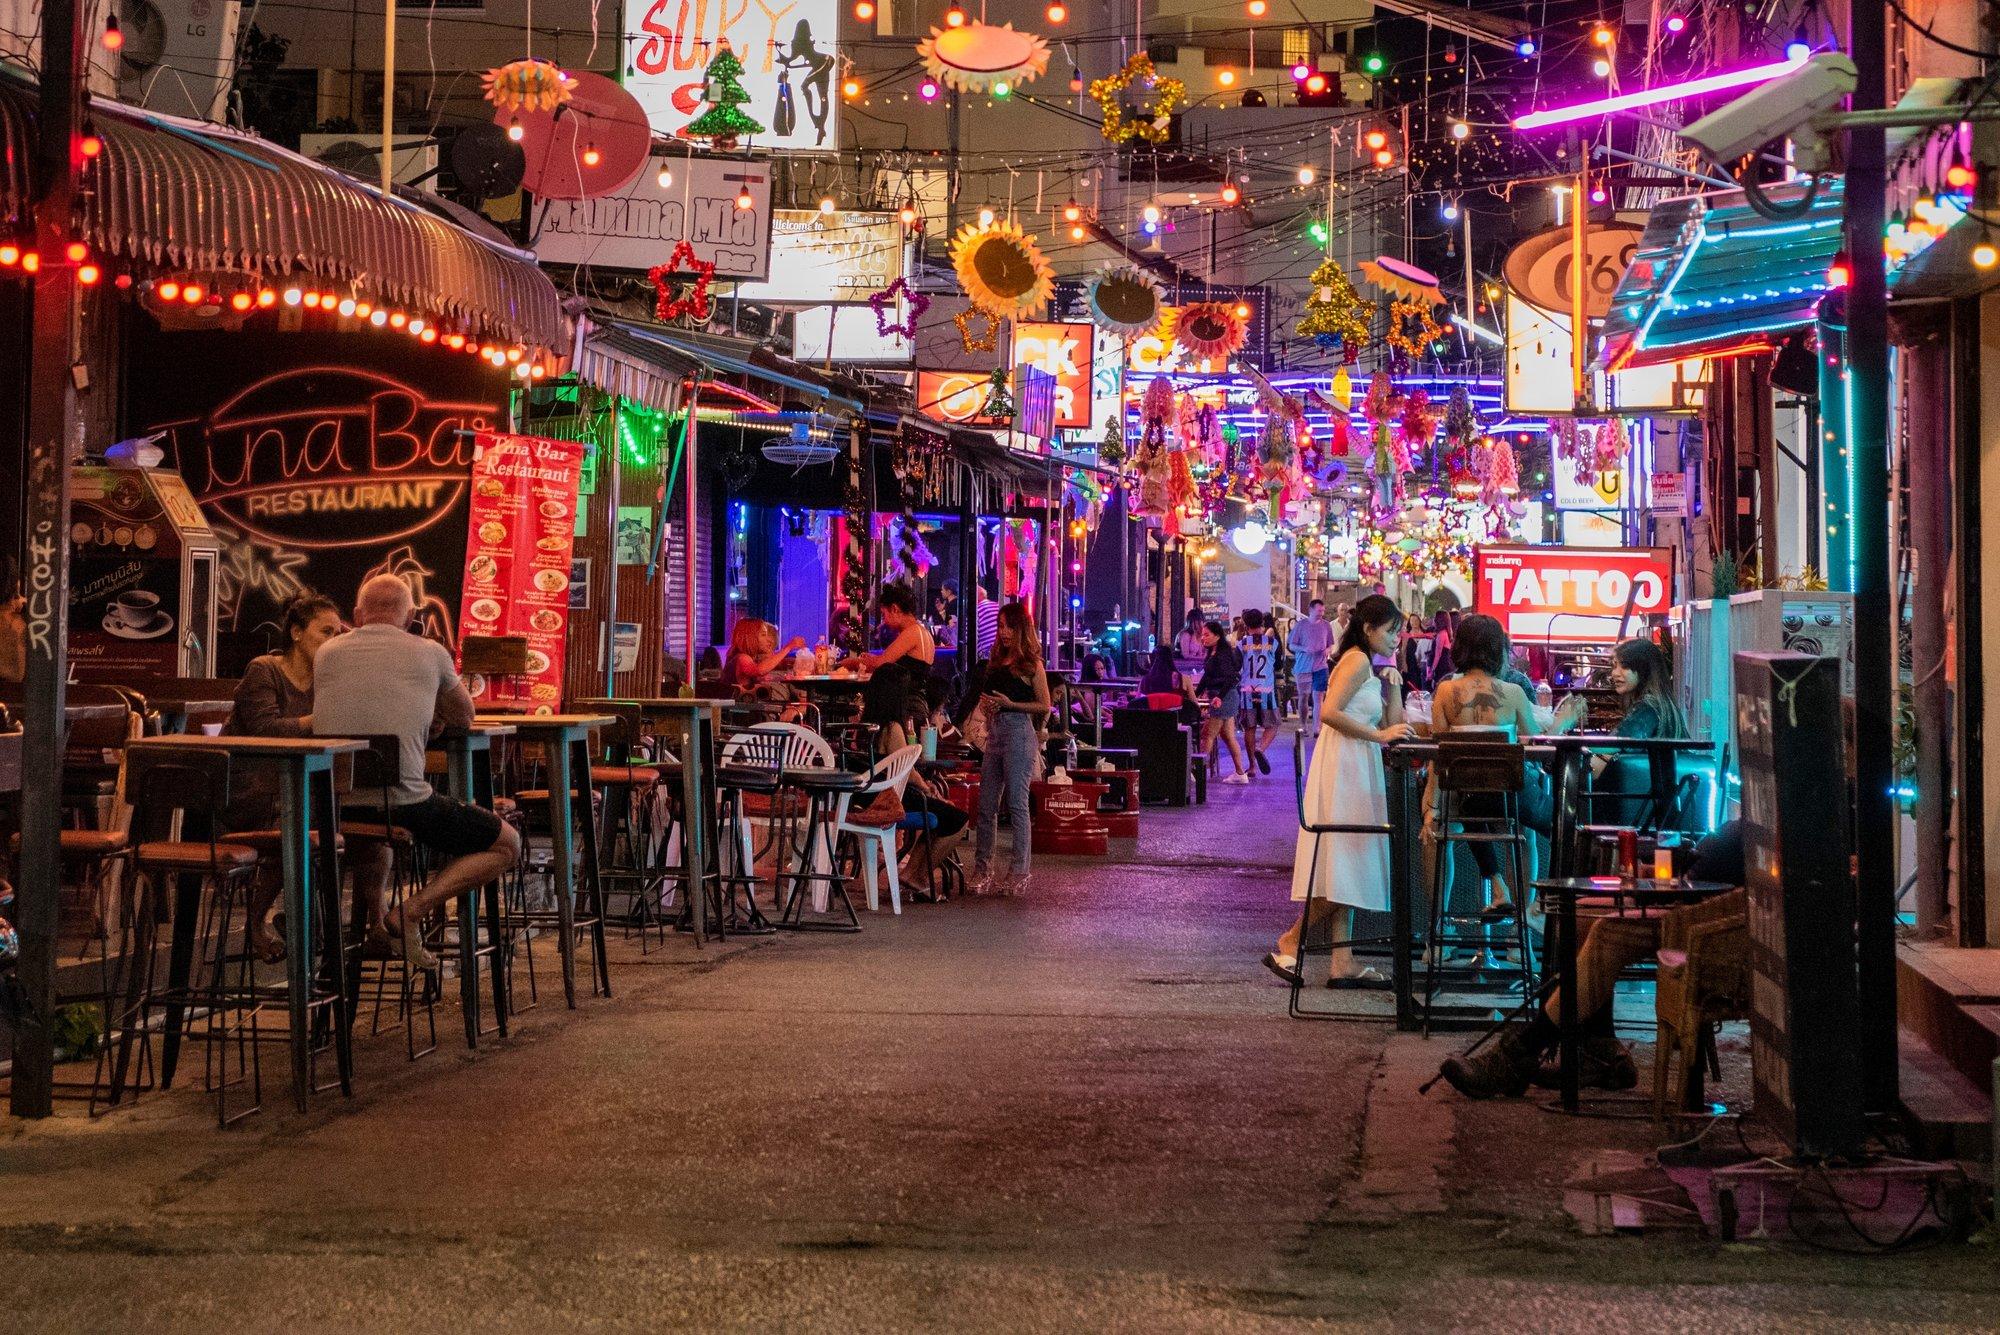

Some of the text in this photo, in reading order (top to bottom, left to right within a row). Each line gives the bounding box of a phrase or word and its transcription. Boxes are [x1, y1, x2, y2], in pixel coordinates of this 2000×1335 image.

[186, 23, 206, 37] LG
[545, 196, 758, 247] Mamma Mia
[771, 218, 813, 232] Welcome
[837, 274, 887, 288] BAR
[148, 417, 352, 494] Tina
[535, 440, 569, 461] Bar
[485, 455, 570, 482] Restaurant
[249, 480, 444, 518] RESTAURANT
[1560, 497, 1577, 505] COLD
[1484, 567, 1664, 609] TATTOO
[1247, 654, 1267, 680] 12
